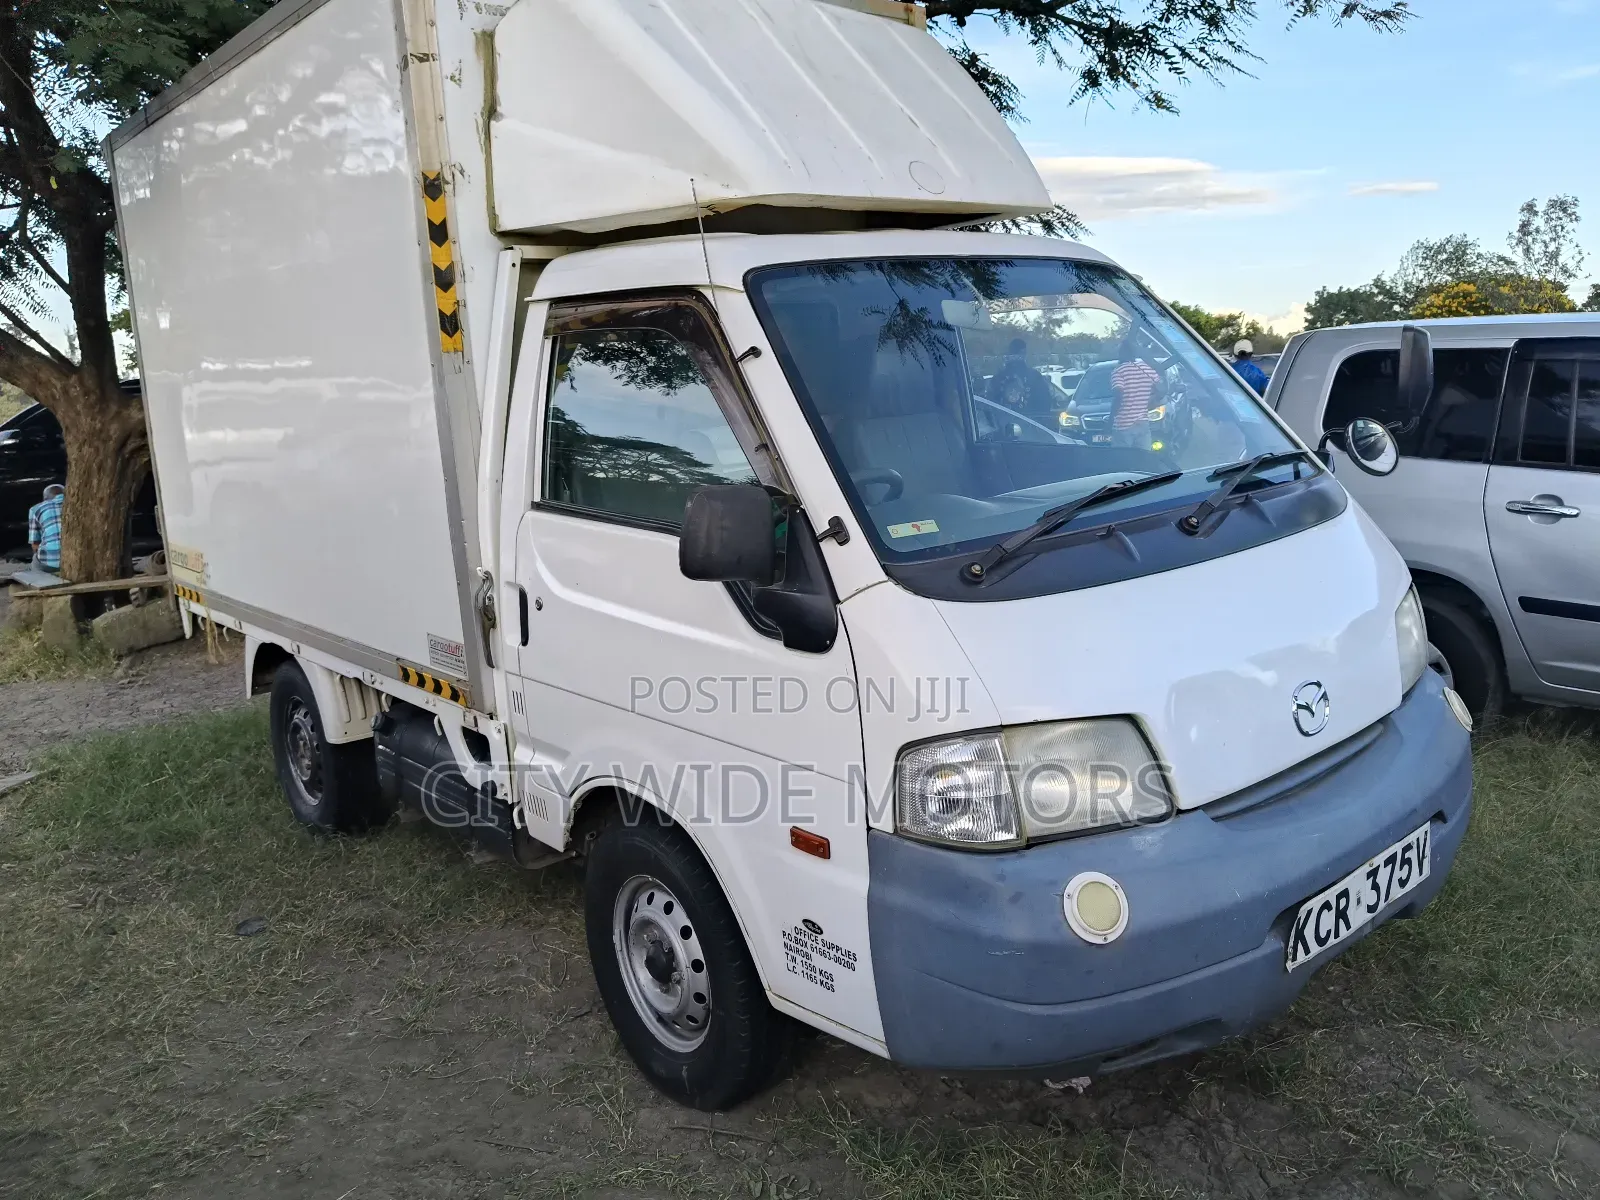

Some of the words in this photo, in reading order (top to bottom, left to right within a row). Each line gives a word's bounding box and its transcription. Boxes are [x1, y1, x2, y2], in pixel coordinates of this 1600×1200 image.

[1291, 887, 1352, 963] KCR
[1366, 829, 1429, 914] 375V
[783, 941, 812, 962] NAIROBI
[794, 926, 819, 945] OFFICE
[820, 938, 858, 962] SUPPLIES
[810, 944, 856, 972] 61663-00200
[785, 952, 799, 965] T.W.
[800, 959, 817, 974] 1550
[818, 967, 834, 983] KGS
[801, 970, 818, 985] 1165
[819, 978, 836, 993] KGS
